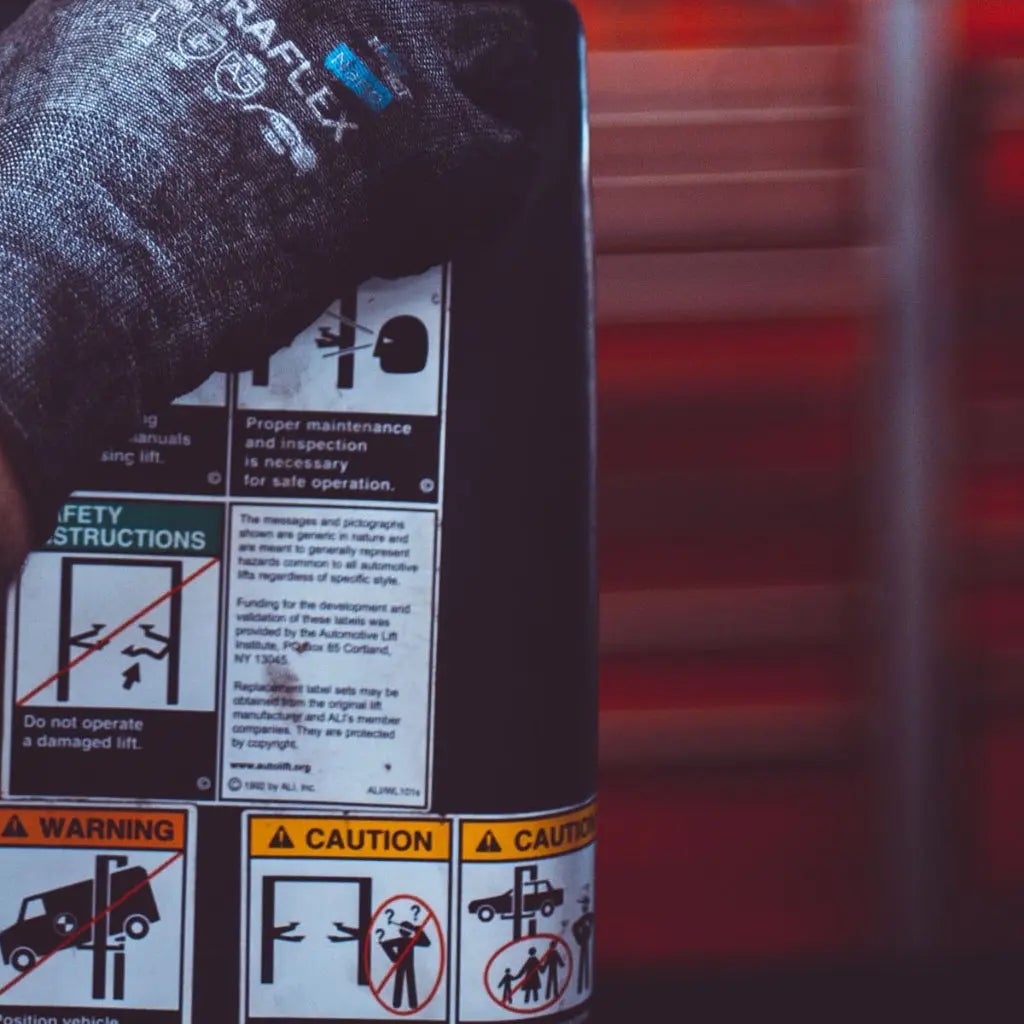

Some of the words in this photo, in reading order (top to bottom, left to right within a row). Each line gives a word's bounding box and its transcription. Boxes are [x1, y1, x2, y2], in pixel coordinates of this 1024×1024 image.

[246, 417, 300, 432] Proper
[306, 419, 412, 435] maintenance
[129, 433, 192, 446] anuals
[245, 438, 275, 450] and
[281, 439, 368, 453] inspection
[101, 449, 135, 466] sing
[245, 456, 258, 468] is
[265, 458, 349, 474] necessary
[244, 474, 266, 487] for
[272, 475, 306, 488] safe
[311, 478, 396, 492] operation.
[58, 504, 123, 525] FETY
[240, 513, 260, 524] The
[263, 516, 317, 528] messages
[321, 518, 341, 527] and
[343, 518, 405, 531] pictographs
[48, 527, 206, 550] STRUCTIONS
[239, 529, 274, 538] shown
[277, 531, 294, 539] are
[296, 531, 336, 542] generic
[339, 533, 349, 541] in
[352, 533, 385, 543] nature
[389, 534, 409, 544] and
[238, 544, 256, 553] are
[259, 544, 293, 553] meant
[295, 544, 306, 554] to
[308, 545, 356, 557] generally
[360, 547, 410, 558] represent
[238, 557, 280, 567] hazards
[283, 559, 329, 568] common
[332, 560, 343, 569] to
[361, 562, 419, 574] automotive
[258, 572, 314, 583] regardless
[316, 573, 328, 582] of
[330, 574, 370, 585] specific
[236, 597, 280, 610] Funding
[282, 599, 296, 609] for
[299, 600, 316, 610] the
[319, 601, 388, 613] development
[390, 604, 411, 614] and
[236, 613, 287, 623] validation
[289, 614, 300, 623] of
[302, 615, 331, 625] these
[369, 618, 390, 627] was
[235, 627, 282, 638] provided
[284, 628, 297, 639] by
[300, 629, 317, 638] the
[319, 628, 379, 641] Automotive
[381, 631, 398, 642] Lift
[234, 654, 252, 664] NY
[234, 680, 303, 693] Replacement
[307, 684, 331, 694] label
[335, 686, 356, 695] sets
[359, 688, 382, 698] may
[385, 688, 399, 697] be
[309, 699, 325, 708] the
[24, 714, 46, 728] Do
[51, 716, 78, 729] not
[82, 718, 143, 732] operate
[304, 713, 326, 722] and
[357, 716, 401, 725] member
[297, 725, 322, 738] They
[326, 729, 342, 737] are
[345, 729, 396, 740] protected
[22, 737, 32, 747] a
[37, 734, 112, 752] damaged
[116, 736, 143, 750] lift.
[231, 738, 245, 749] by
[39, 816, 175, 842] WARNING
[306, 828, 434, 852] CAUTION
[61, 1013, 120, 1024] vehicle
